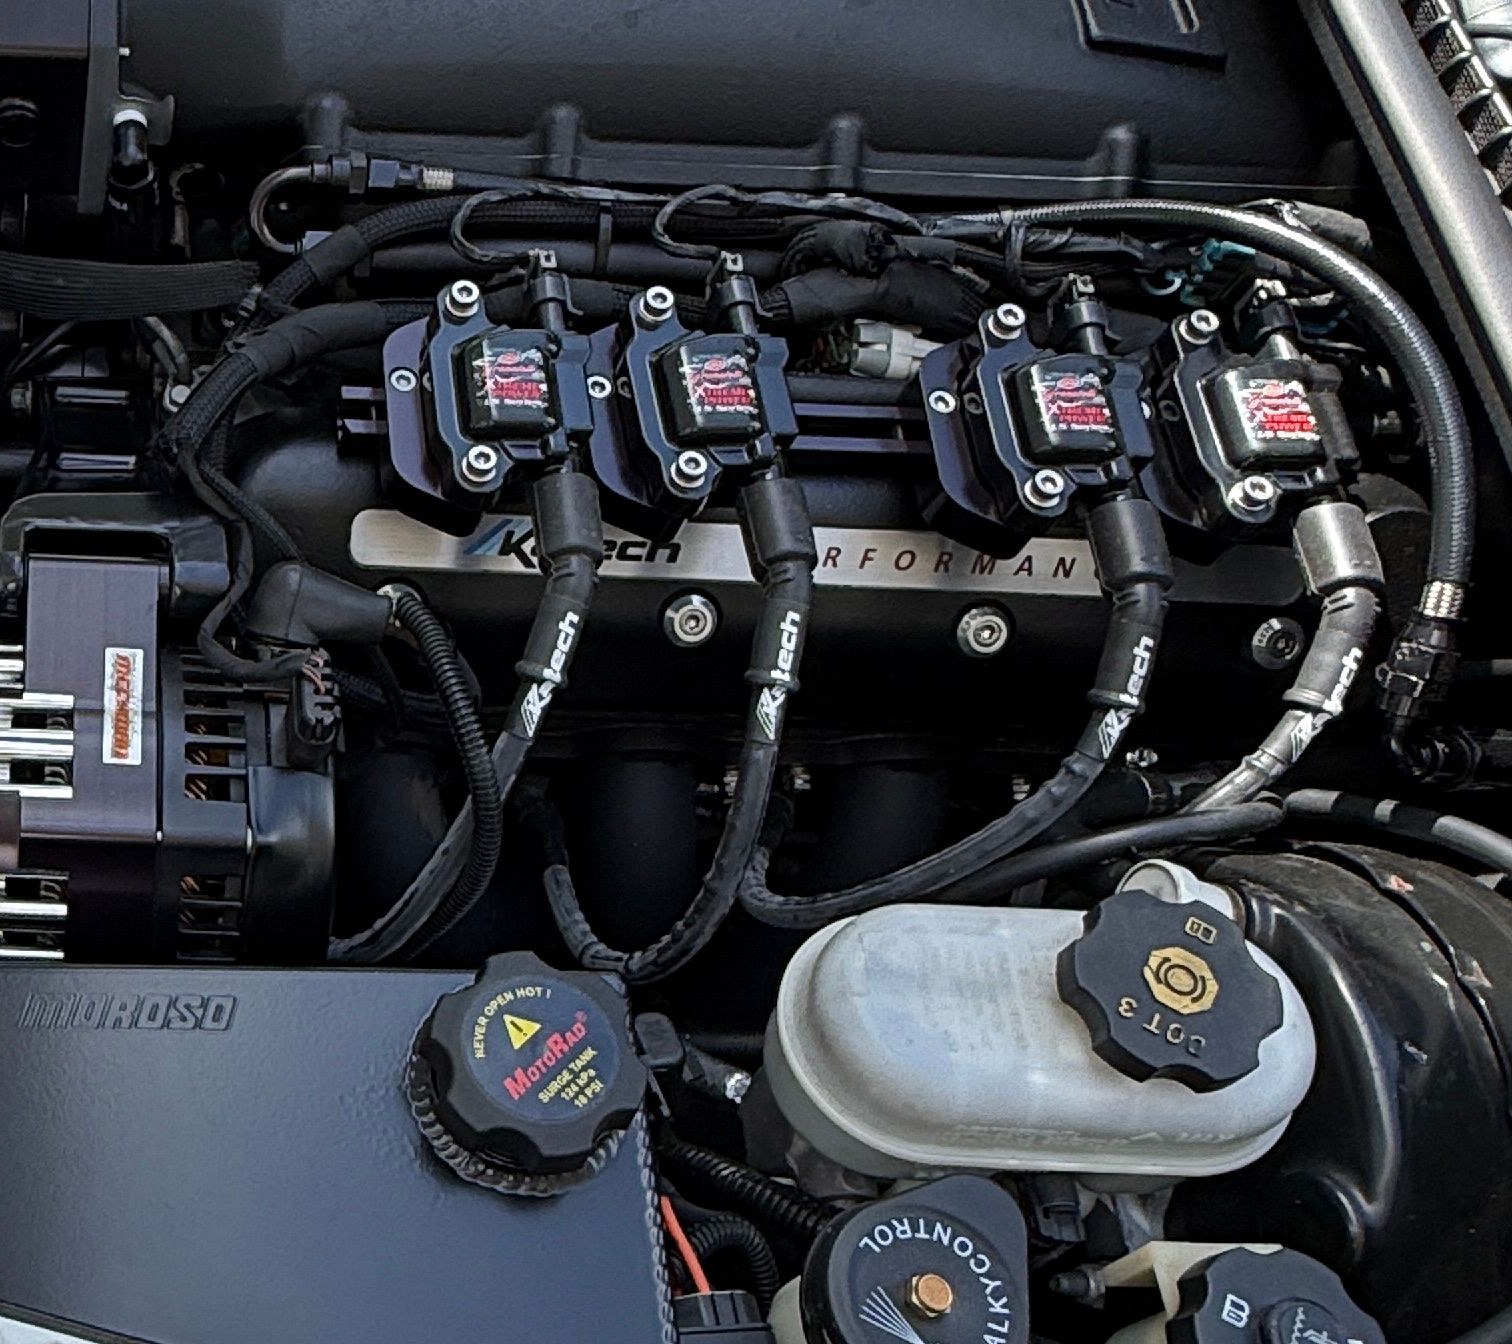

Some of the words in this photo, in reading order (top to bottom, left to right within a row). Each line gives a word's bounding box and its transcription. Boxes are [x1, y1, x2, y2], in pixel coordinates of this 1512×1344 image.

[498, 529, 682, 569] Kech
[17, 993, 237, 1031] MOROSO
[472, 1016, 489, 1060] NEVER
[484, 991, 515, 1017] OPEN
[514, 986, 544, 998] HOT
[538, 1068, 574, 1104] SURGE
[569, 1045, 599, 1072] TANK
[584, 1079, 605, 1099] PSI
